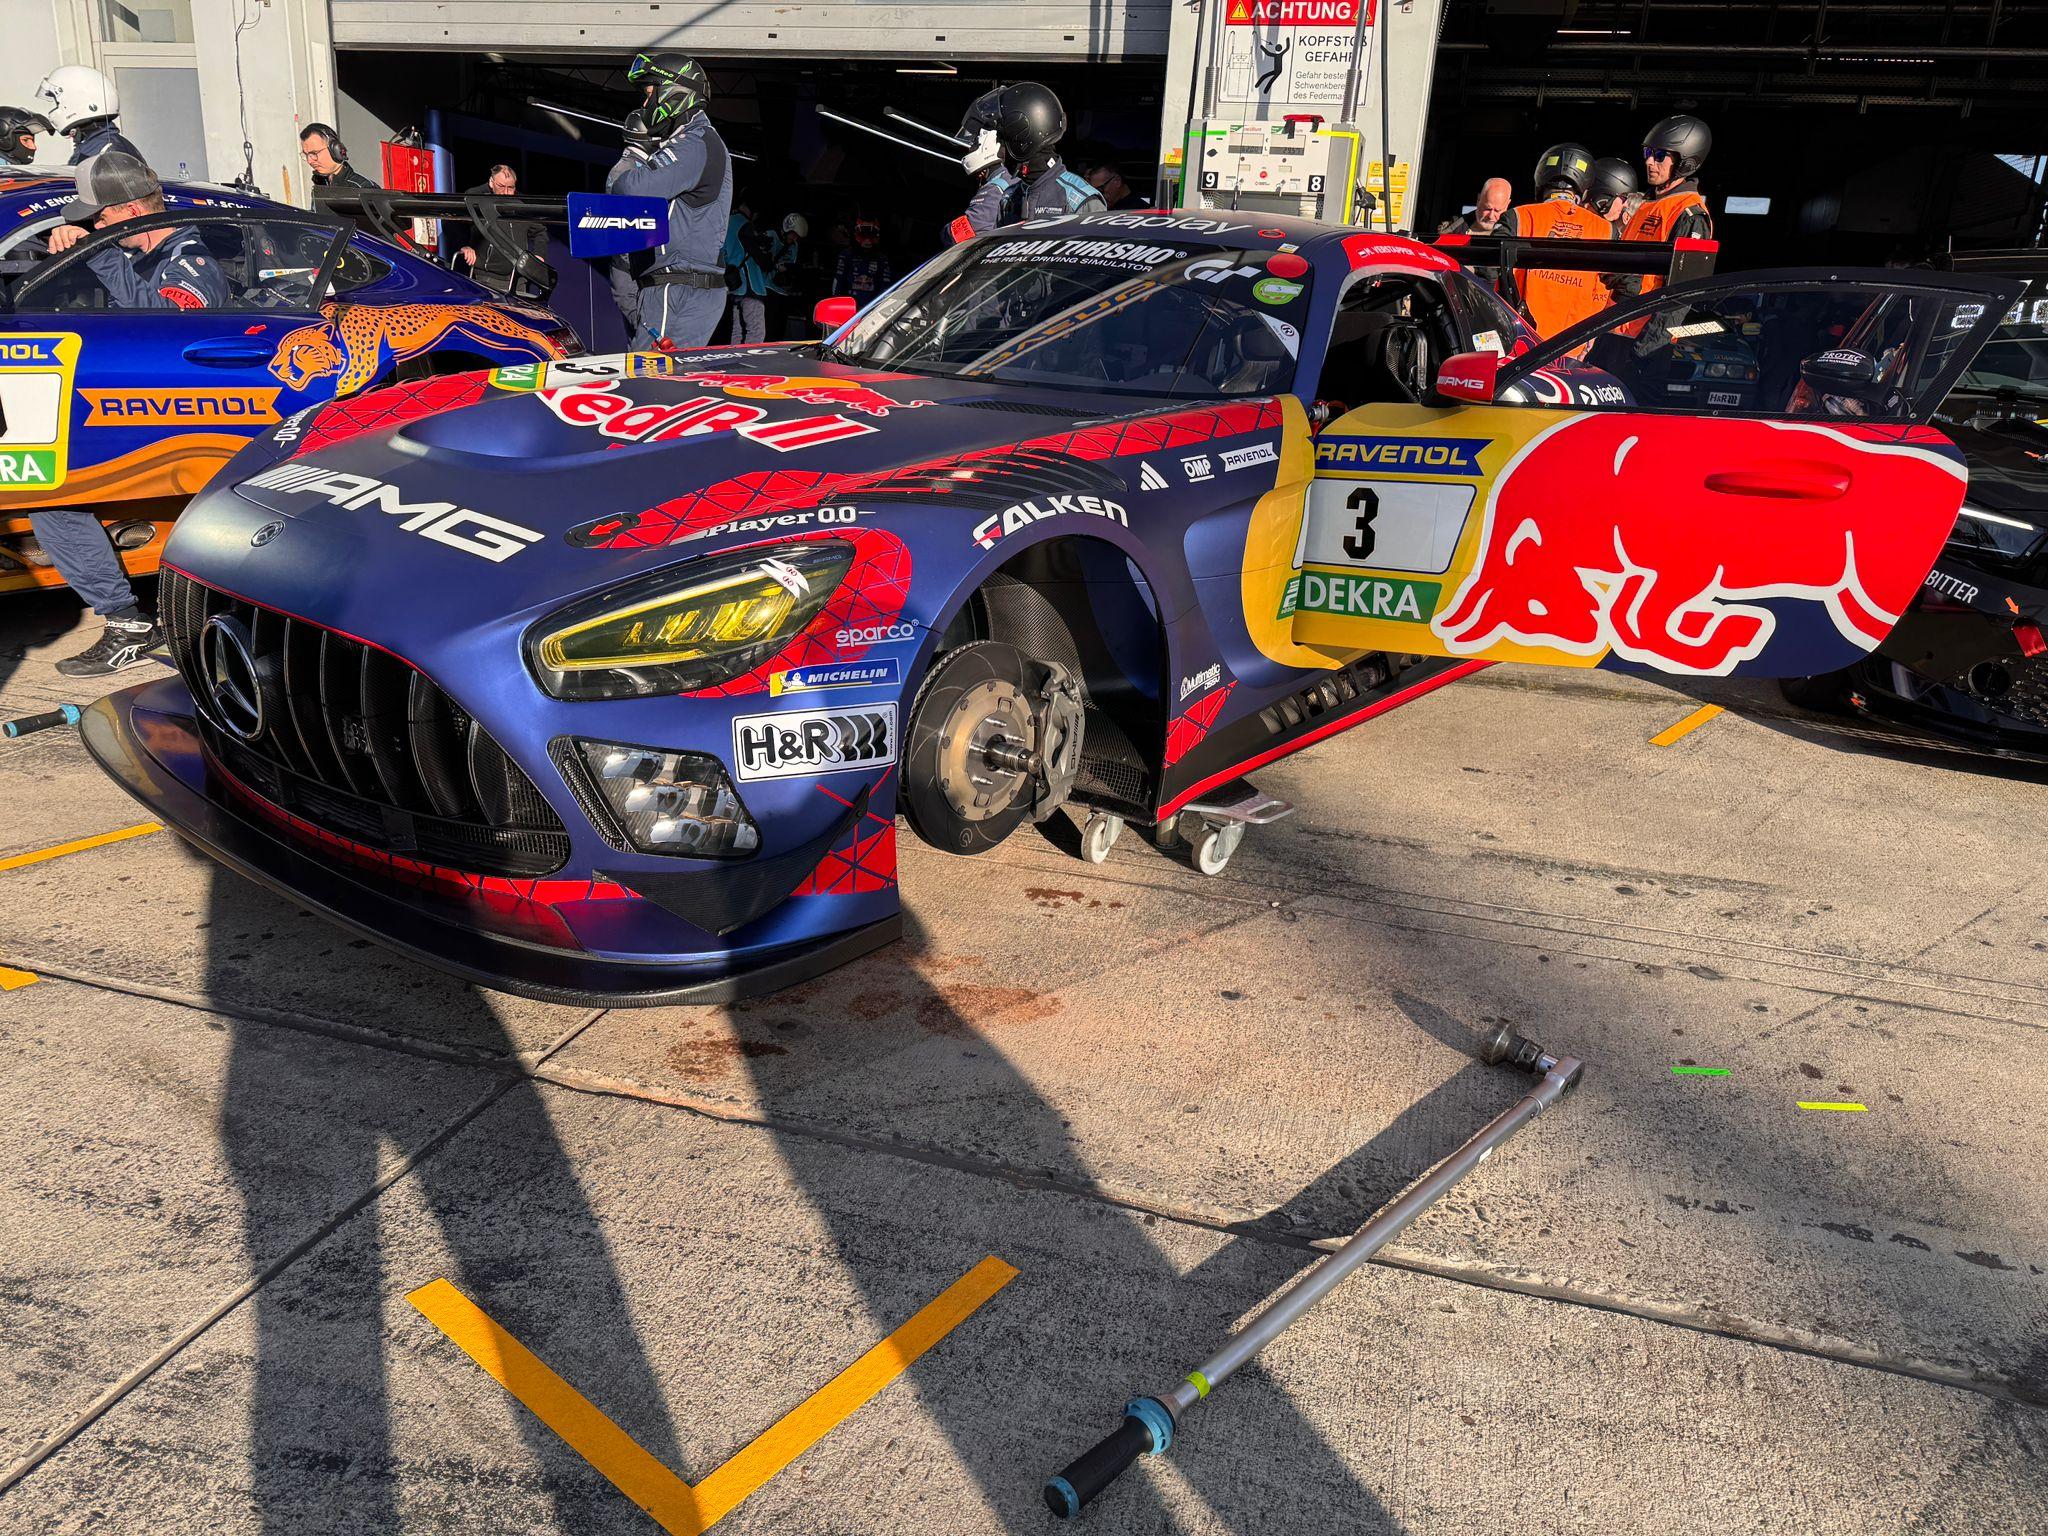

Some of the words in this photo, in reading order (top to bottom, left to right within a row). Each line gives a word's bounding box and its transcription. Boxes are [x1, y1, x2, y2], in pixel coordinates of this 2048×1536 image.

[1250, 2, 1351, 20] ACHTUNG
[1296, 71, 1322, 79] Gefahr
[1205, 173, 1216, 188] 9
[1311, 176, 1322, 192] 8
[605, 218, 656, 230] AMG
[1081, 214, 1253, 236] viaplay
[986, 240, 1060, 258] GRAN
[1001, 256, 1028, 264] REAL
[1032, 256, 1078, 265] DRIVING
[1079, 258, 1154, 273] SIMULATOR
[1538, 270, 1584, 288] MARSHAL
[1822, 352, 1863, 362] PROTEC
[555, 362, 620, 376] 3
[1443, 376, 1484, 390] AMG
[1595, 382, 1627, 405] viaplay
[100, 397, 267, 417] RAVENOL
[1226, 448, 1273, 467] RAVENOL
[1315, 443, 1468, 466] RAVENOL
[1183, 458, 1212, 478] OMP
[284, 471, 546, 563] AMG
[704, 511, 816, 538] Player
[971, 494, 1129, 550] FALKEN
[1343, 487, 1380, 561] 3
[1924, 569, 1979, 604] BITTER
[1304, 575, 1422, 620] DEKRA
[807, 667, 888, 684] MICHELIN
[742, 719, 836, 768] H&R
